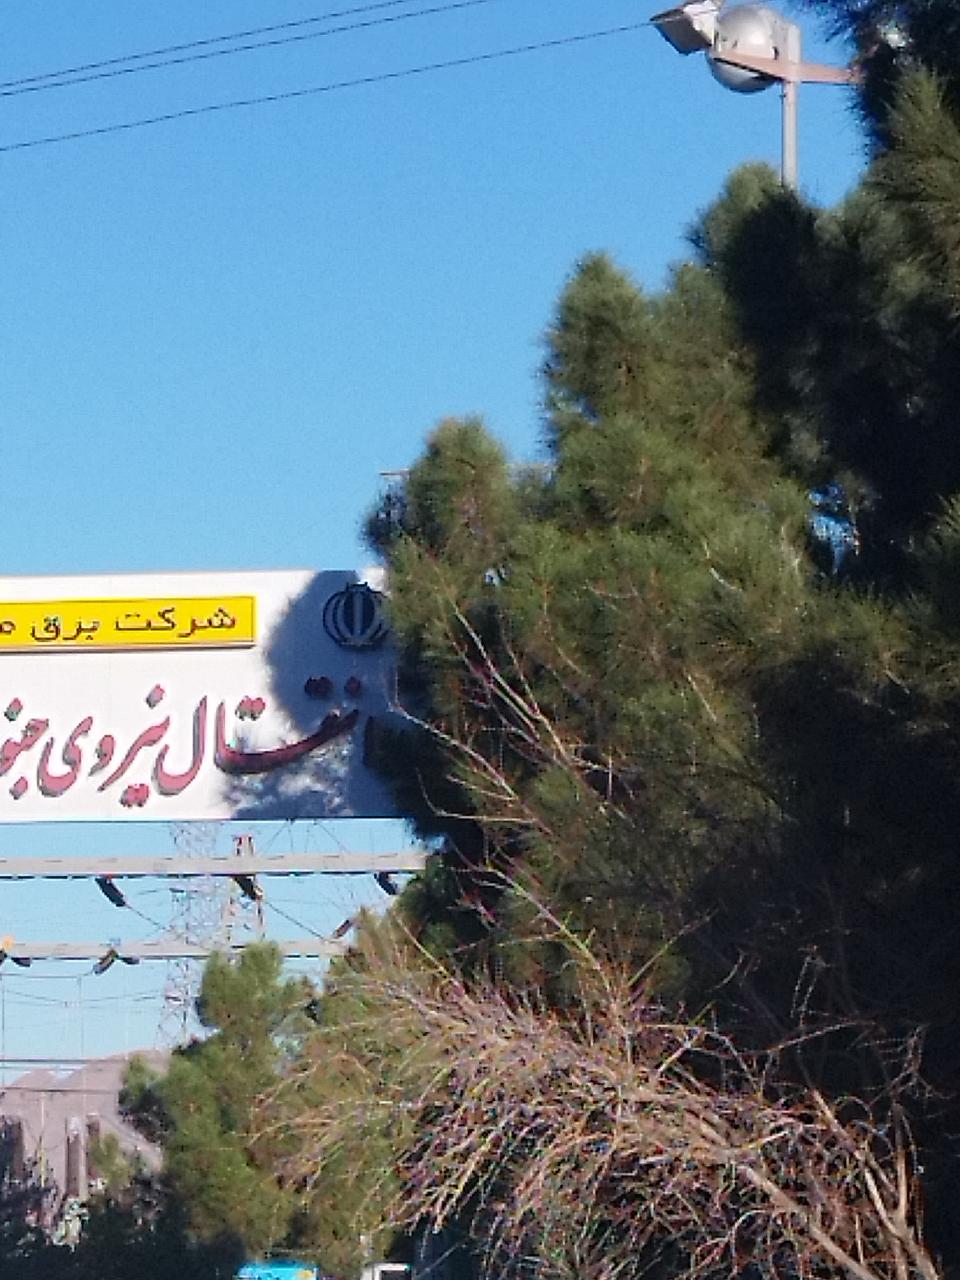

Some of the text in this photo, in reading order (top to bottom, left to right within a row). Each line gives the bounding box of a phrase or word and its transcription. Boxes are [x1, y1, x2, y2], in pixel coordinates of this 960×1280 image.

[30, 616, 100, 642] برق
[114, 607, 236, 638] شرکت
[36, 684, 170, 808] نیروی
